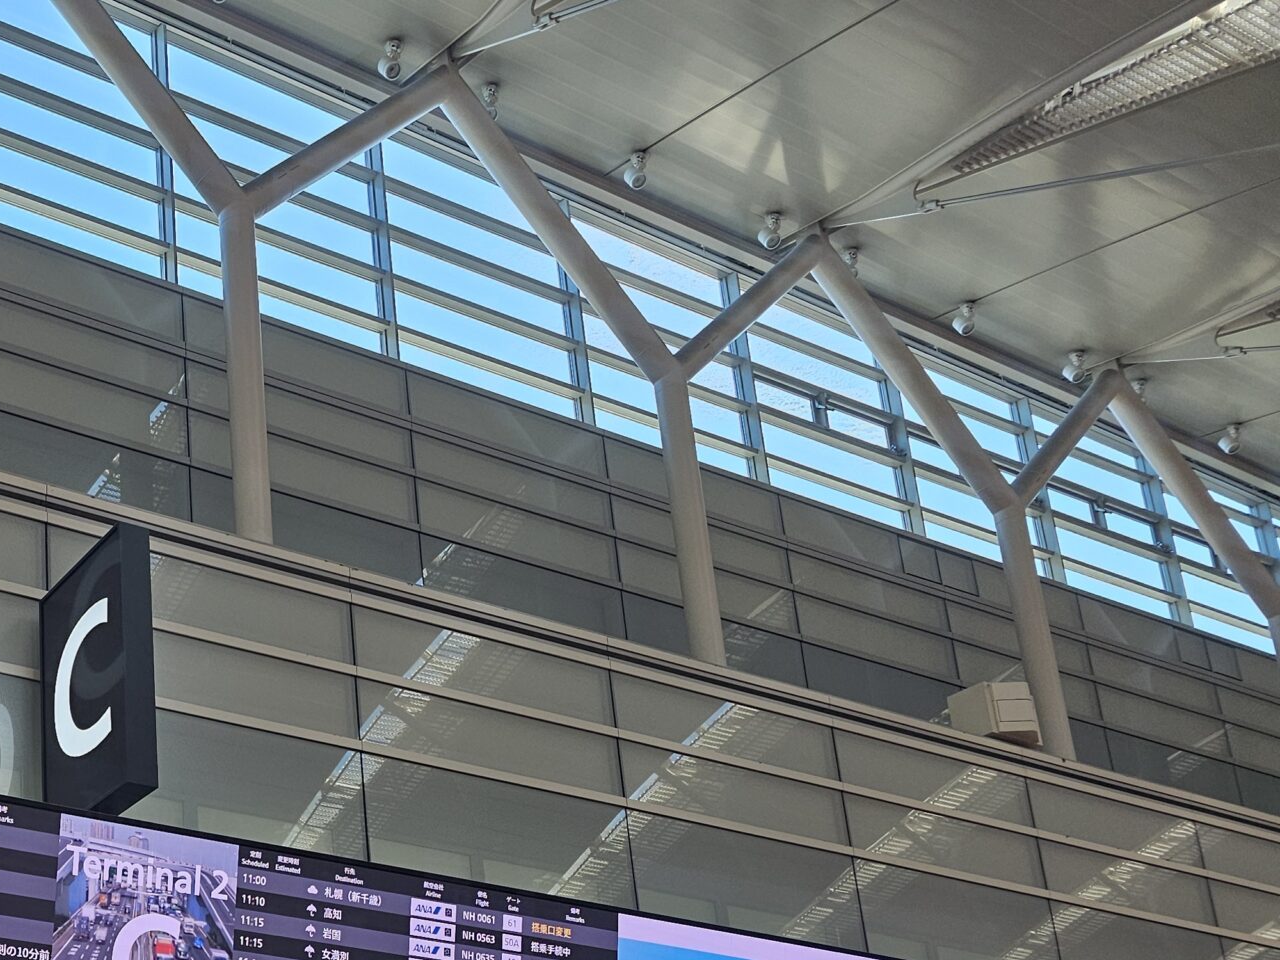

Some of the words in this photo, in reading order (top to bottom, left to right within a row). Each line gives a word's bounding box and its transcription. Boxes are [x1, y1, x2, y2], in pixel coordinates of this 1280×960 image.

[54, 597, 112, 757] C
[67, 844, 202, 898] Terminal
[211, 869, 229, 901] 2
[243, 873, 266, 886] 11:00
[463, 911, 475, 921] NH
[477, 914, 495, 925] 0061
[240, 936, 263, 948] 11:15
